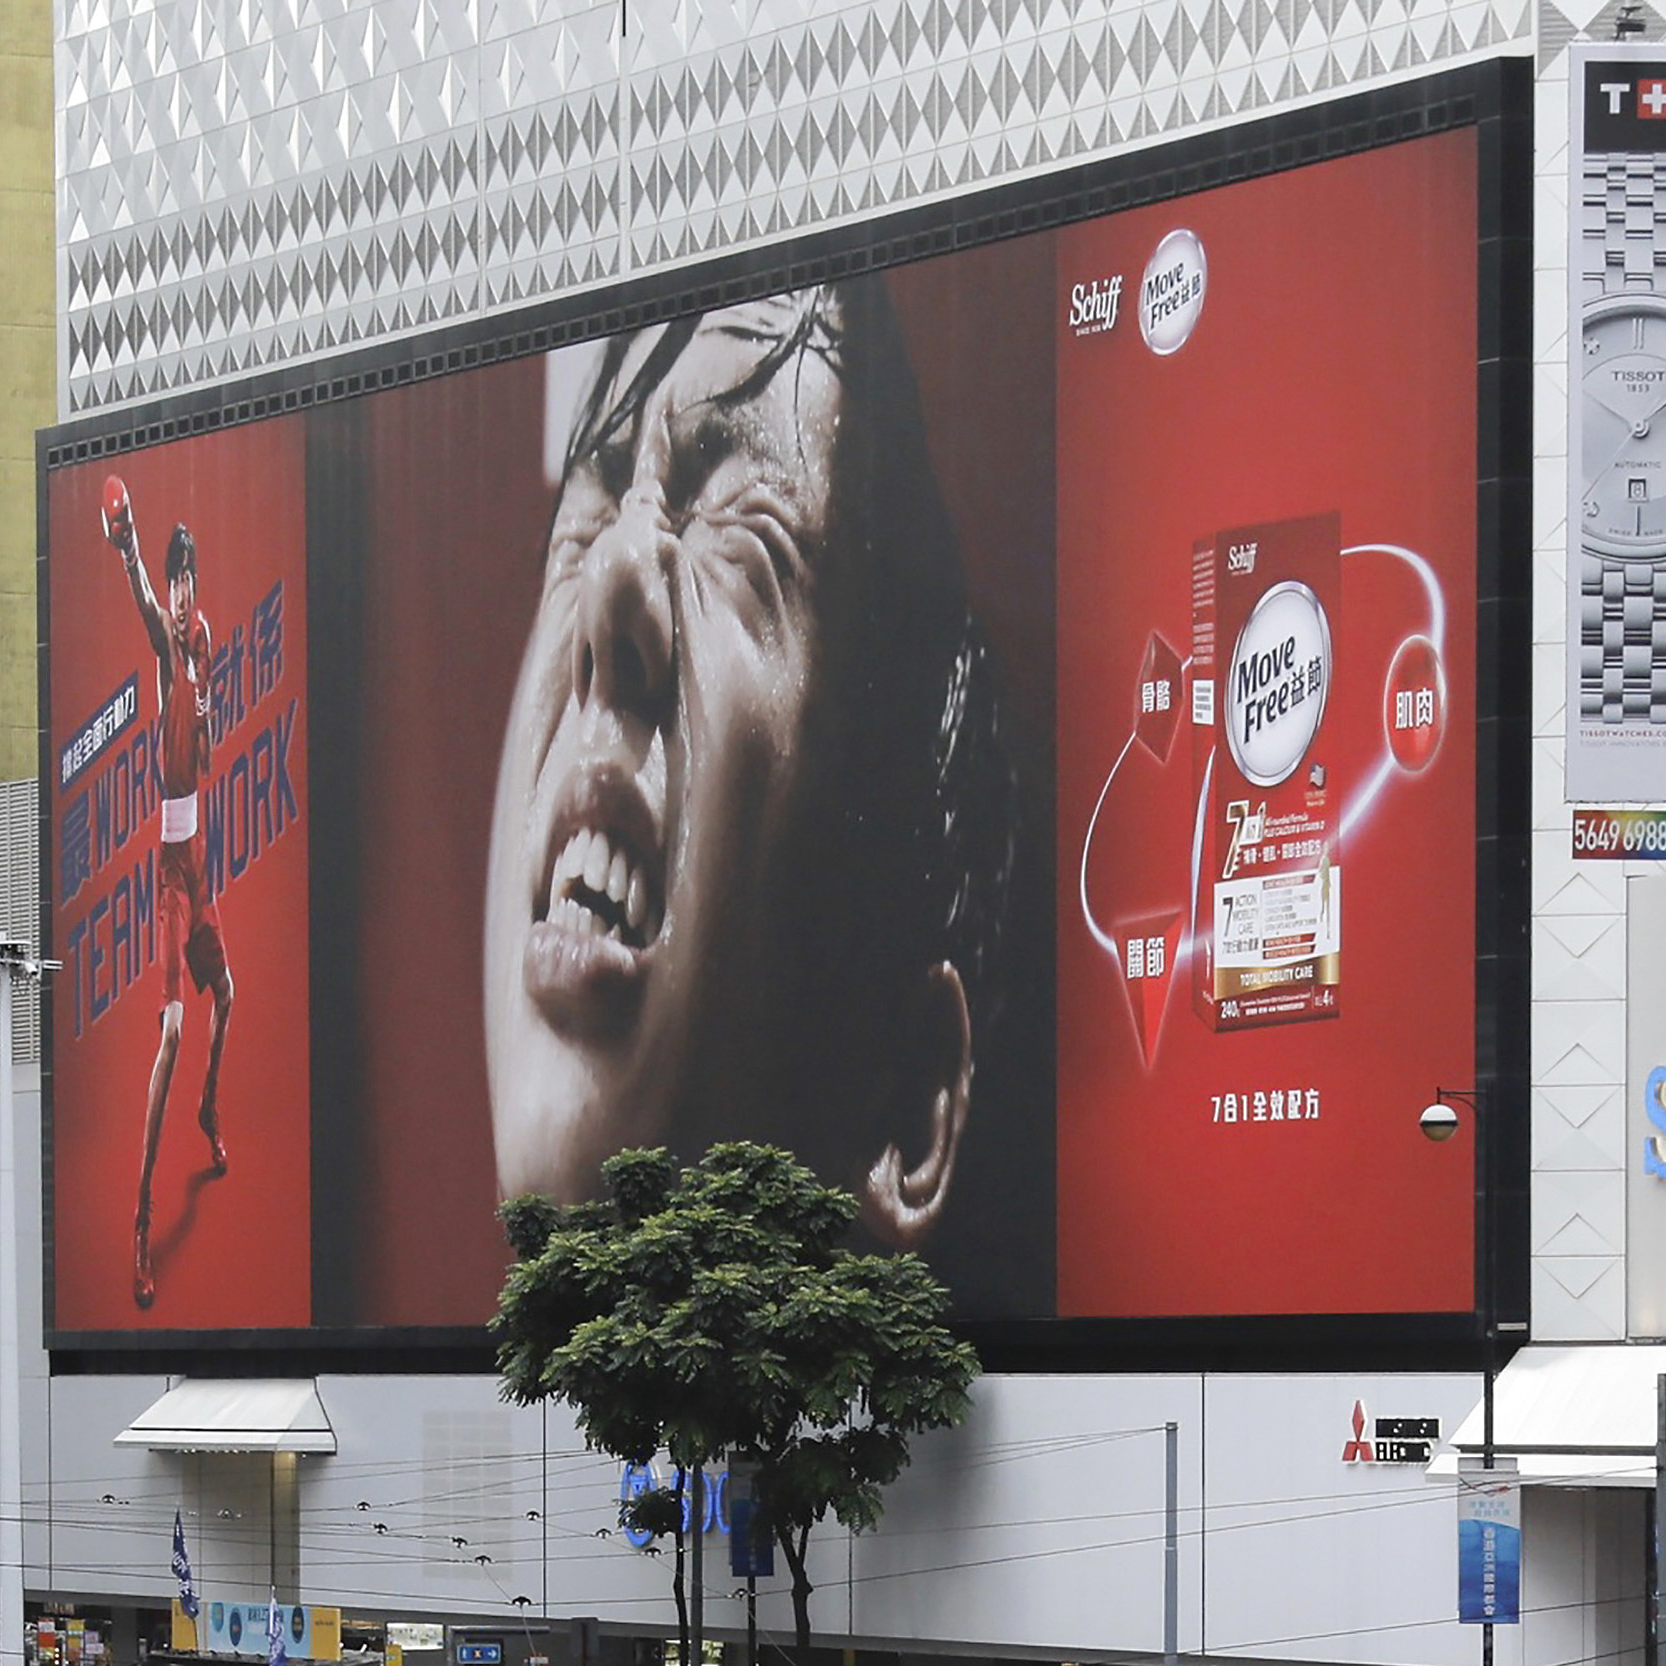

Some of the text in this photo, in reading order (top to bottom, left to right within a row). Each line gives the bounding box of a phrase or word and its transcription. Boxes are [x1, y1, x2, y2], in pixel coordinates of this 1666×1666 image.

[1069, 274, 1123, 331] Schiff
[1146, 262, 1184, 306] Move
[1149, 290, 1179, 330] Free
[1611, 371, 1666, 381] TISSOT
[1236, 635, 1296, 704] Move
[1243, 683, 1289, 745] Free
[1394, 687, 1434, 731] 肌肉
[1574, 818, 1620, 851] 5649
[68, 697, 299, 1042] TEAM WORK
[1126, 936, 1165, 978] 關節
[1210, 1088, 1320, 1124] 7合1全效配方
